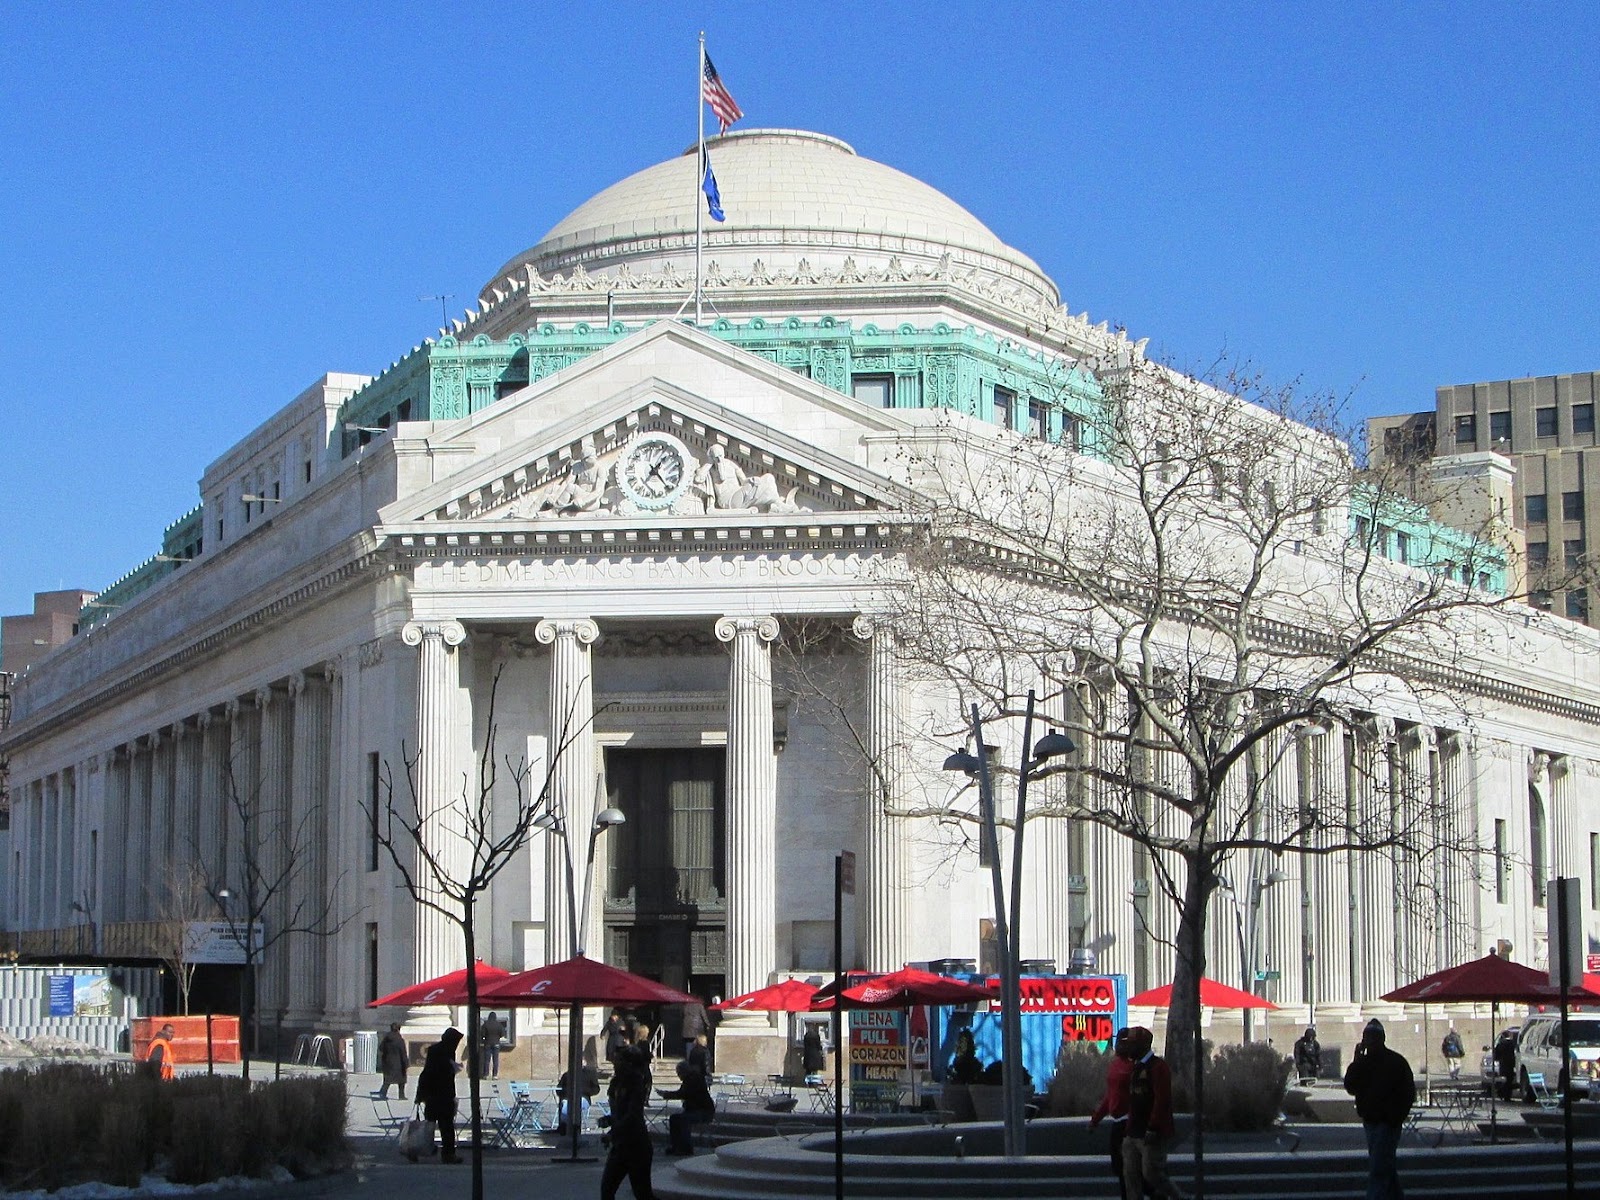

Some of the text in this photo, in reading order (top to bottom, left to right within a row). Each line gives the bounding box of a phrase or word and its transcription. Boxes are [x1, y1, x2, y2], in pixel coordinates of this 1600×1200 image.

[426, 557, 889, 583] THE DIME SAVINGS BANK OF BROOKLYN
[1054, 985, 1111, 1006] NICO
[853, 1012, 894, 1026] LLENA
[1062, 1015, 1113, 1042] SOUP
[860, 1030, 889, 1045] FULL
[851, 1048, 906, 1062] CORAZON
[865, 1066, 898, 1080] HEART
